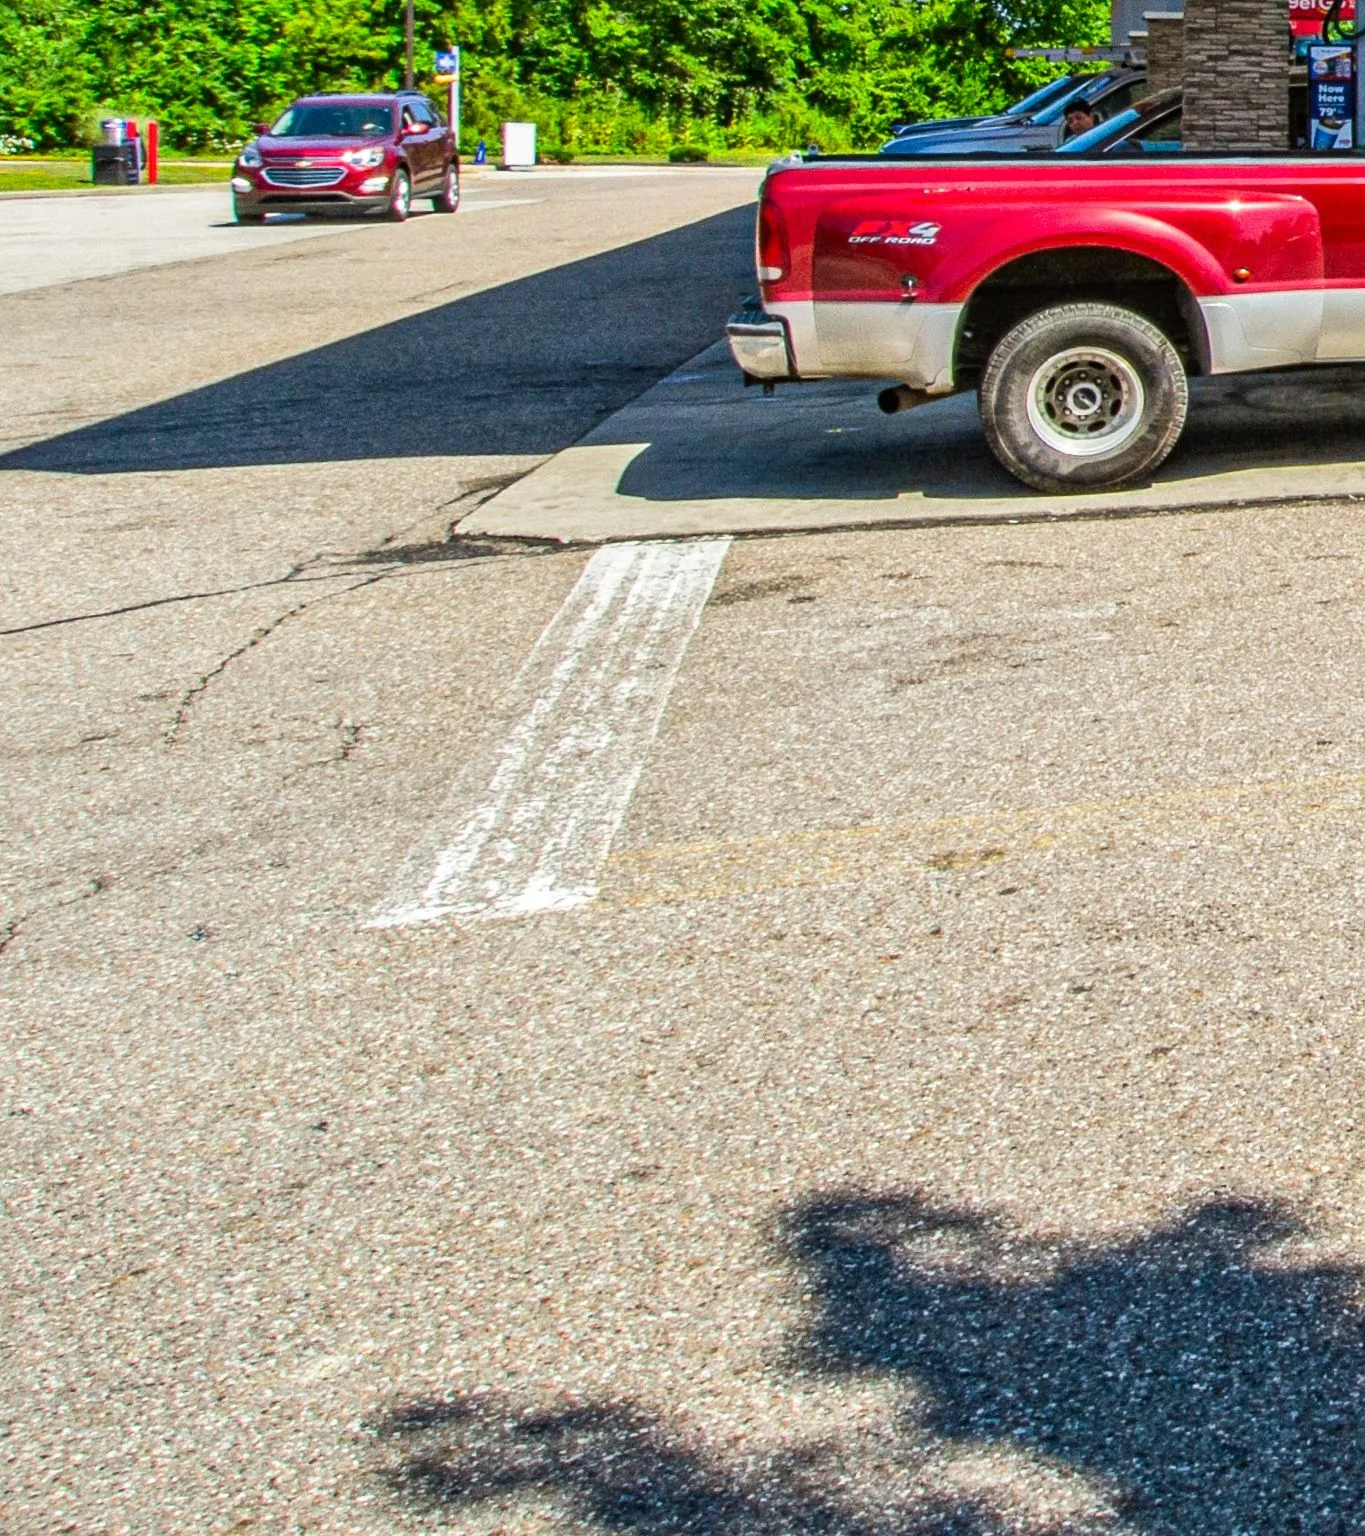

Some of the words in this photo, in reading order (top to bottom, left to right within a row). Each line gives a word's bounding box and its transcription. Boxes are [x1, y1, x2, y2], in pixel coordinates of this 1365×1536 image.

[1318, 84, 1345, 93] Now
[1318, 94, 1345, 102] Here
[847, 236, 881, 244] OFF
[884, 237, 937, 245] ROAD
